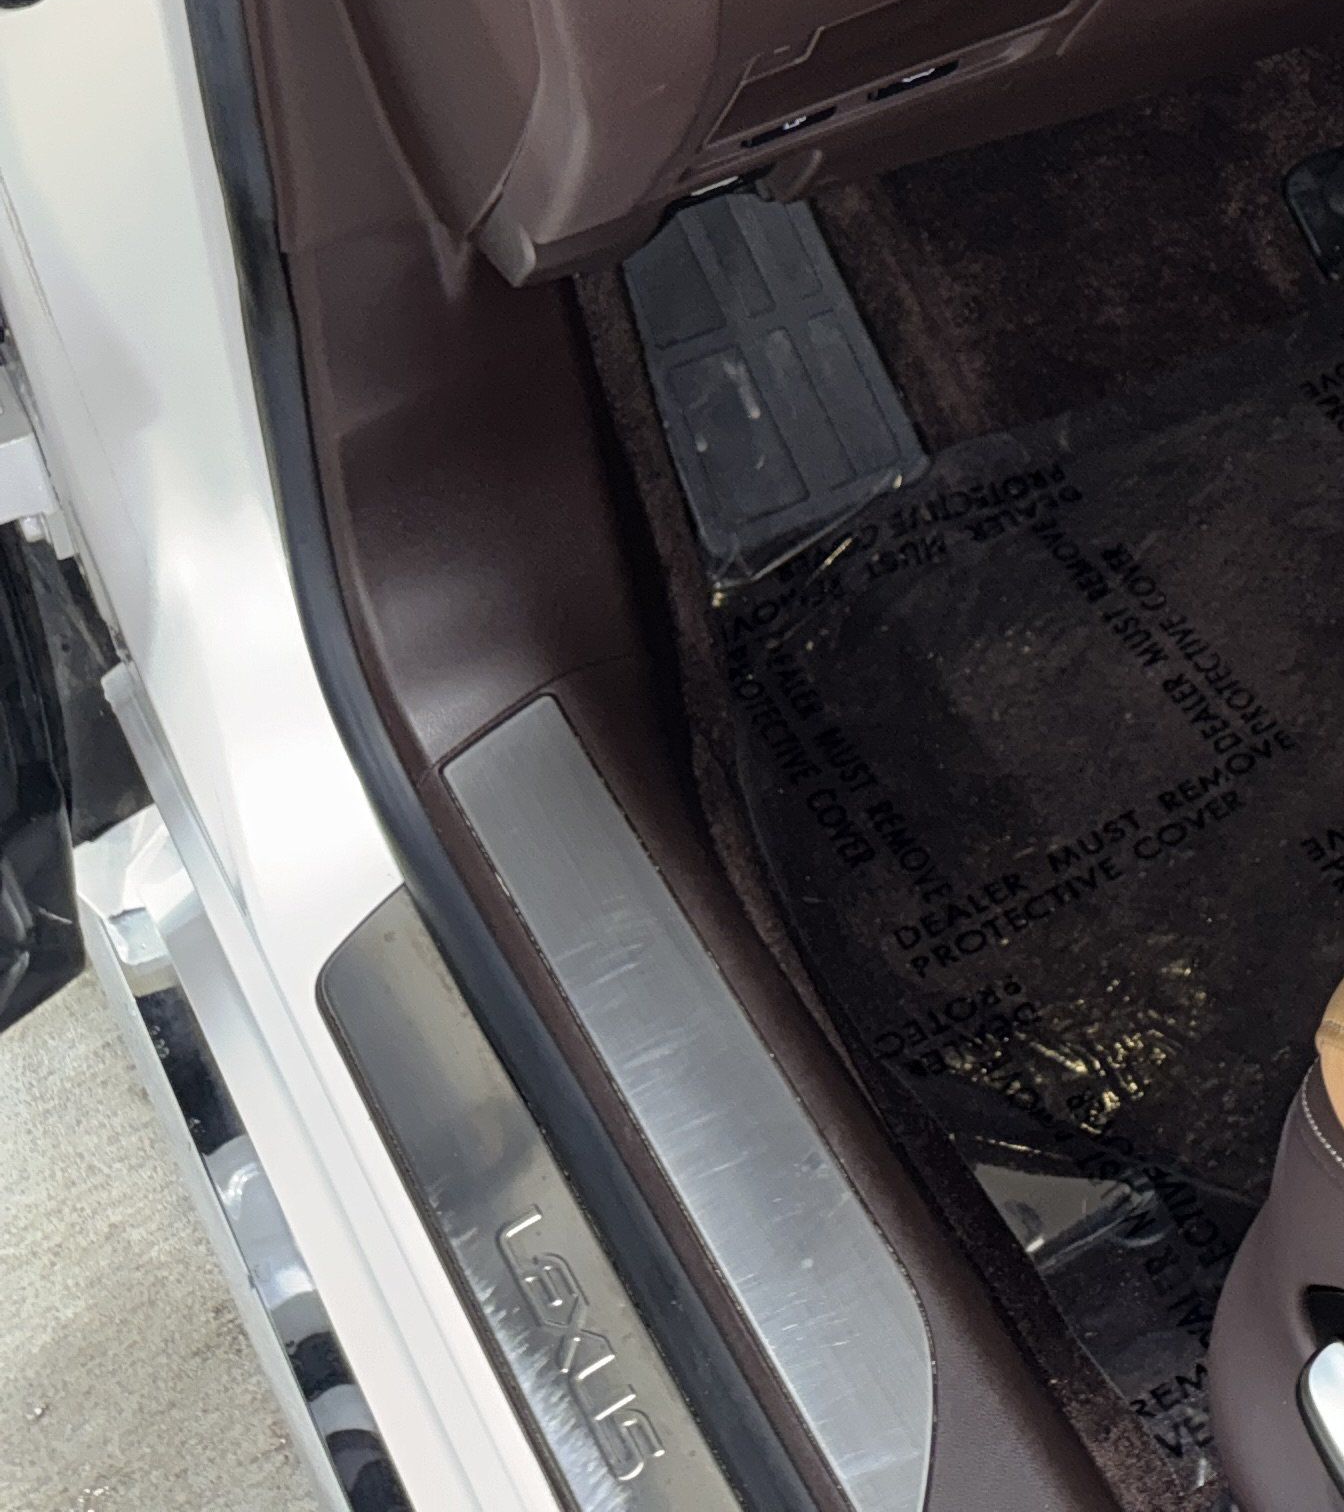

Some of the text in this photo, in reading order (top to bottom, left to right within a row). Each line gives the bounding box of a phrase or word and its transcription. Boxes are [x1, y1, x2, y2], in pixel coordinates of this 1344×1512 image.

[1031, 518, 1243, 755] DEALER MUST REMOVE
[1102, 543, 1277, 736] PROTECTIVE COVER
[807, 789, 875, 869] COVER
[815, 726, 879, 793] MUST
[868, 800, 952, 904] REMOVE
[894, 873, 1027, 951] DEALER
[1047, 810, 1140, 873] MUST
[910, 791, 1243, 978] PROTECTIVE COVER
